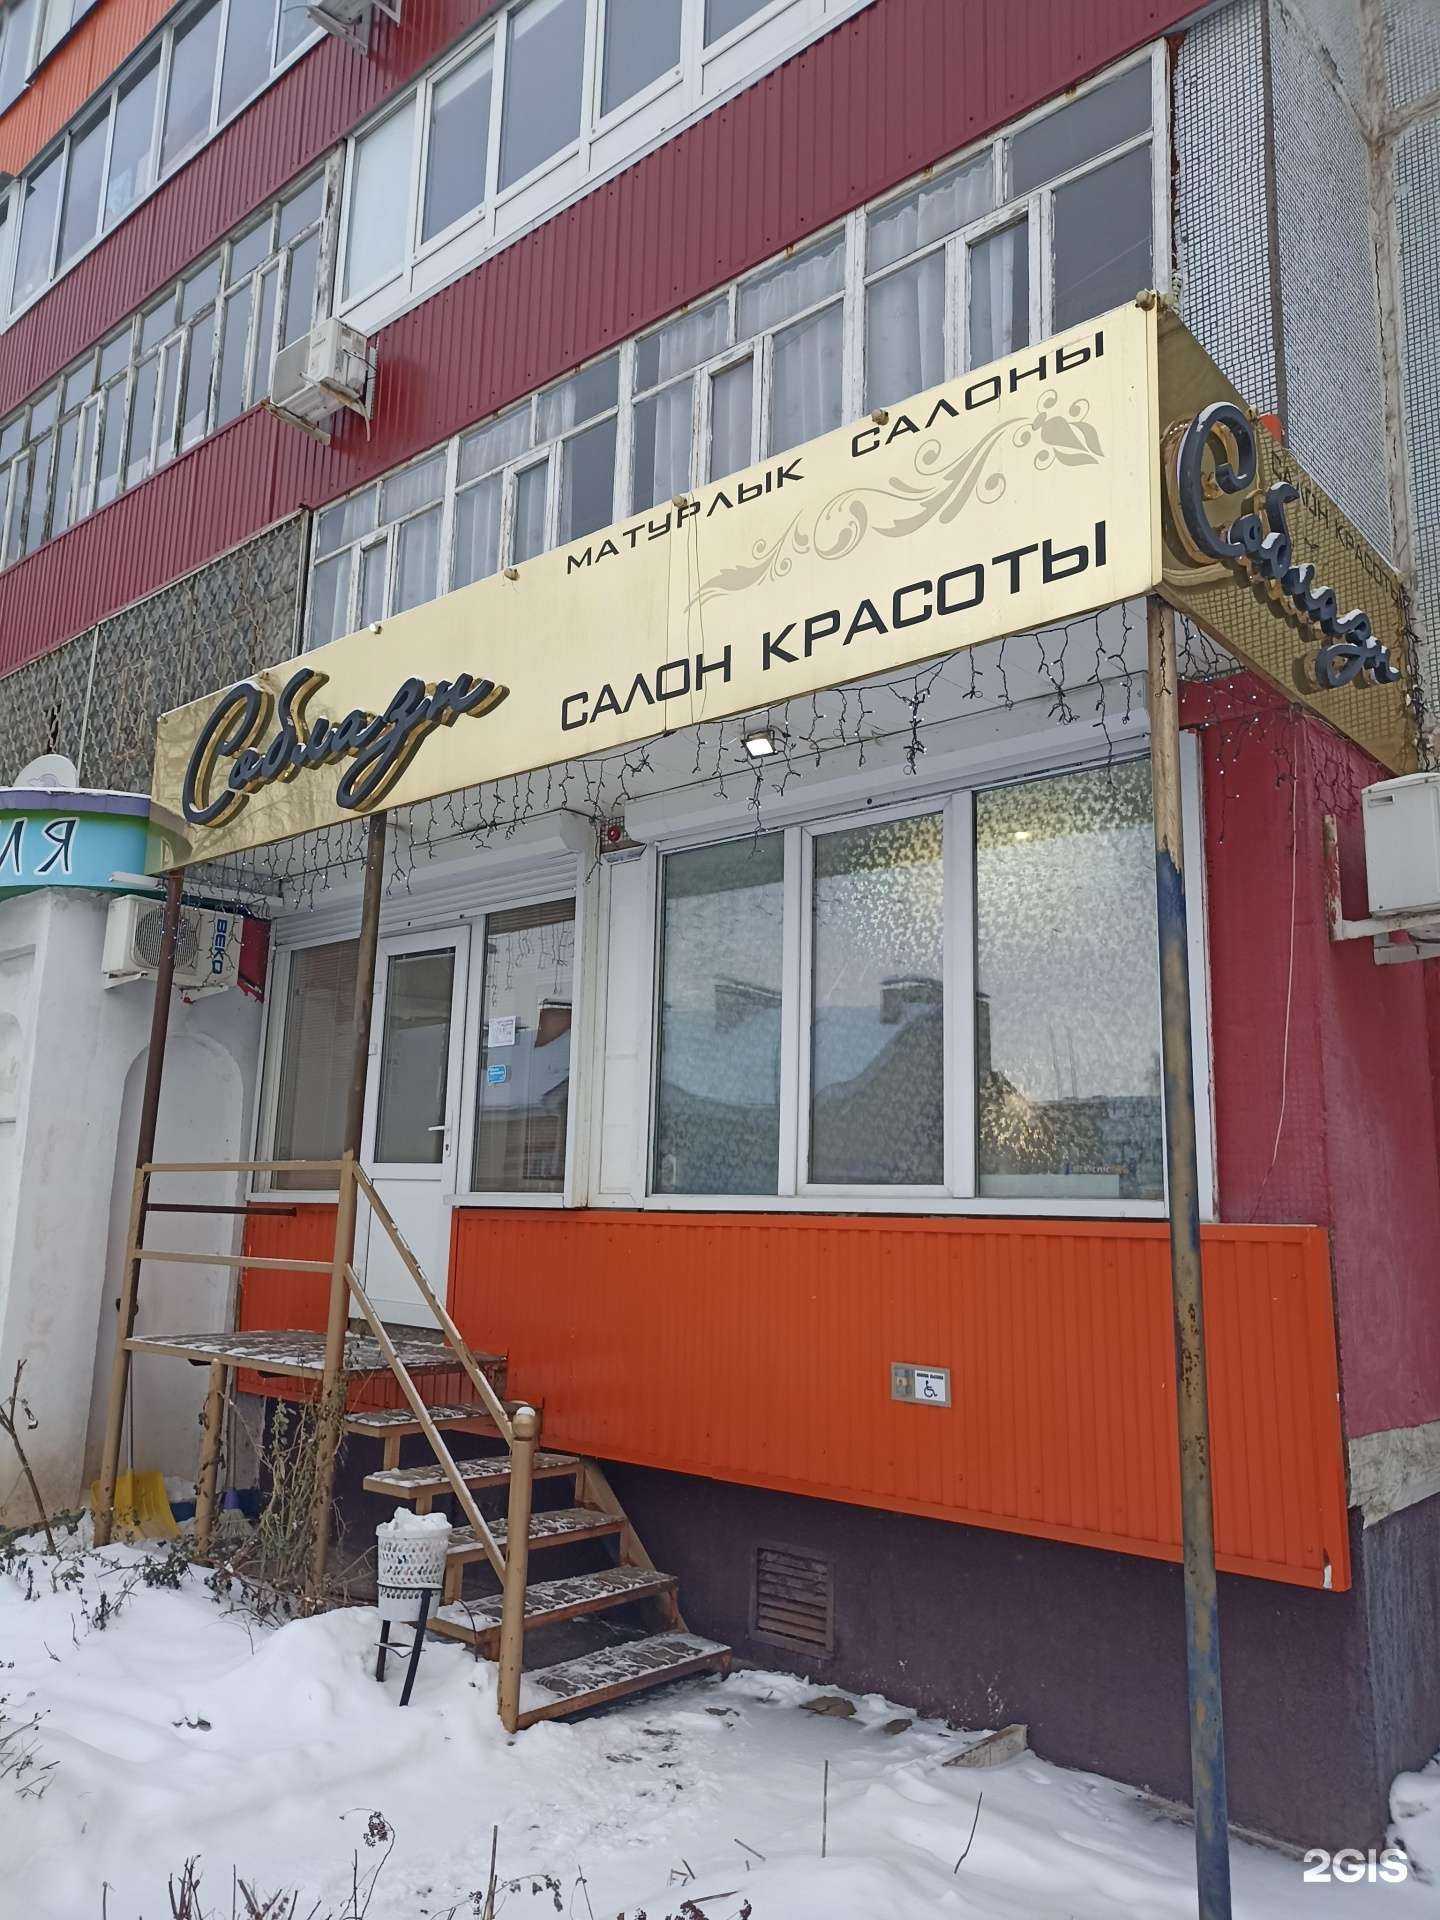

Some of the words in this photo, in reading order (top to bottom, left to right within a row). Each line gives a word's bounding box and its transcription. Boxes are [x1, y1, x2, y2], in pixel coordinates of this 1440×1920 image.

[567, 457, 805, 575] МАТУРЛЫК
[851, 330, 1105, 458] САЛОНЫ
[1178, 401, 1401, 688] Соблазн
[561, 644, 732, 731] САЛОН
[762, 520, 1108, 671] КРАСОТЫ
[182, 667, 506, 828] Соблазн
